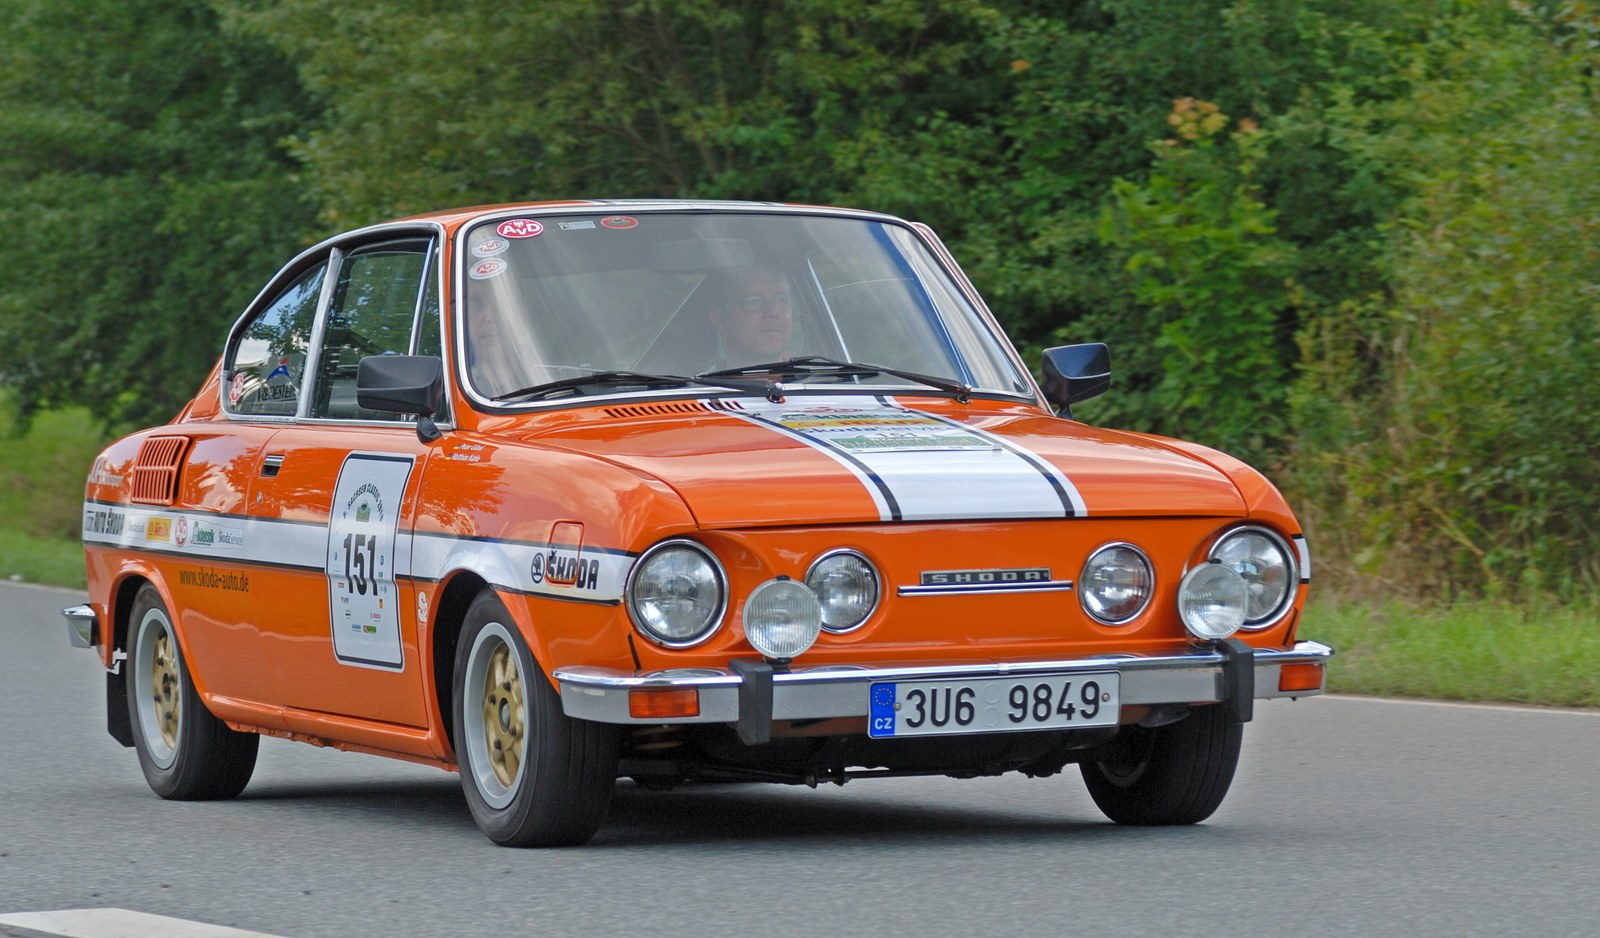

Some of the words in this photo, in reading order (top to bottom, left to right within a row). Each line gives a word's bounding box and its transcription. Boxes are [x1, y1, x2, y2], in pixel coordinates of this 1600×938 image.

[502, 222, 541, 236] AvD
[179, 565, 249, 592] www.skoda-auto.de
[343, 533, 378, 597] 151
[905, 688, 976, 729] 3U6
[1008, 680, 1100, 723] 9849
[874, 717, 893, 731] CZ
